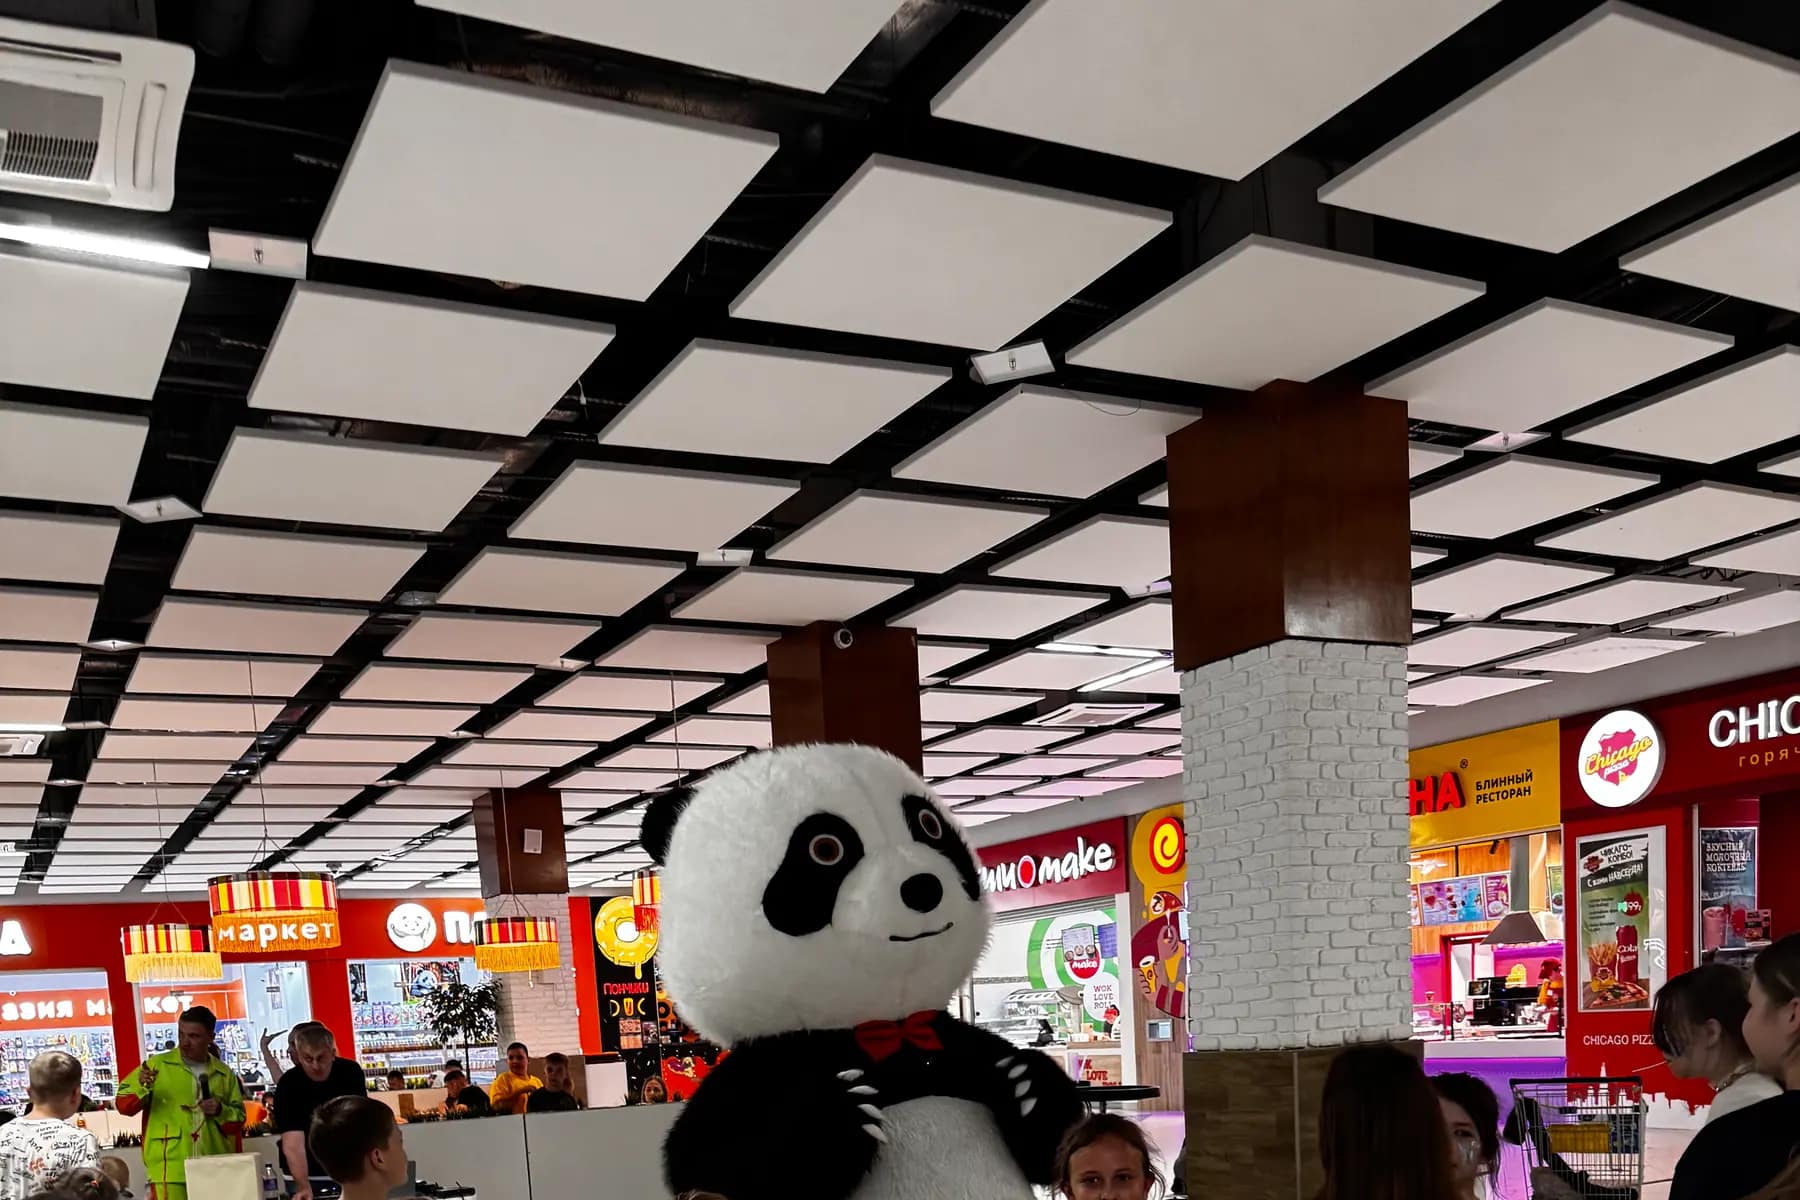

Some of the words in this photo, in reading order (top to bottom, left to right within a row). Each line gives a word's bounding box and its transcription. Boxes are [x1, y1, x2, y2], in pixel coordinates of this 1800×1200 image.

[1585, 736, 1653, 775] Chicago
[1475, 769, 1533, 791] БЛИННЫЙ
[1475, 786, 1532, 804] РЕСТОРАН
[1038, 836, 1113, 884] make
[218, 922, 335, 949] маркет
[1093, 993, 1114, 1001] LOVE
[1583, 1035, 1629, 1046] CHICAGO
